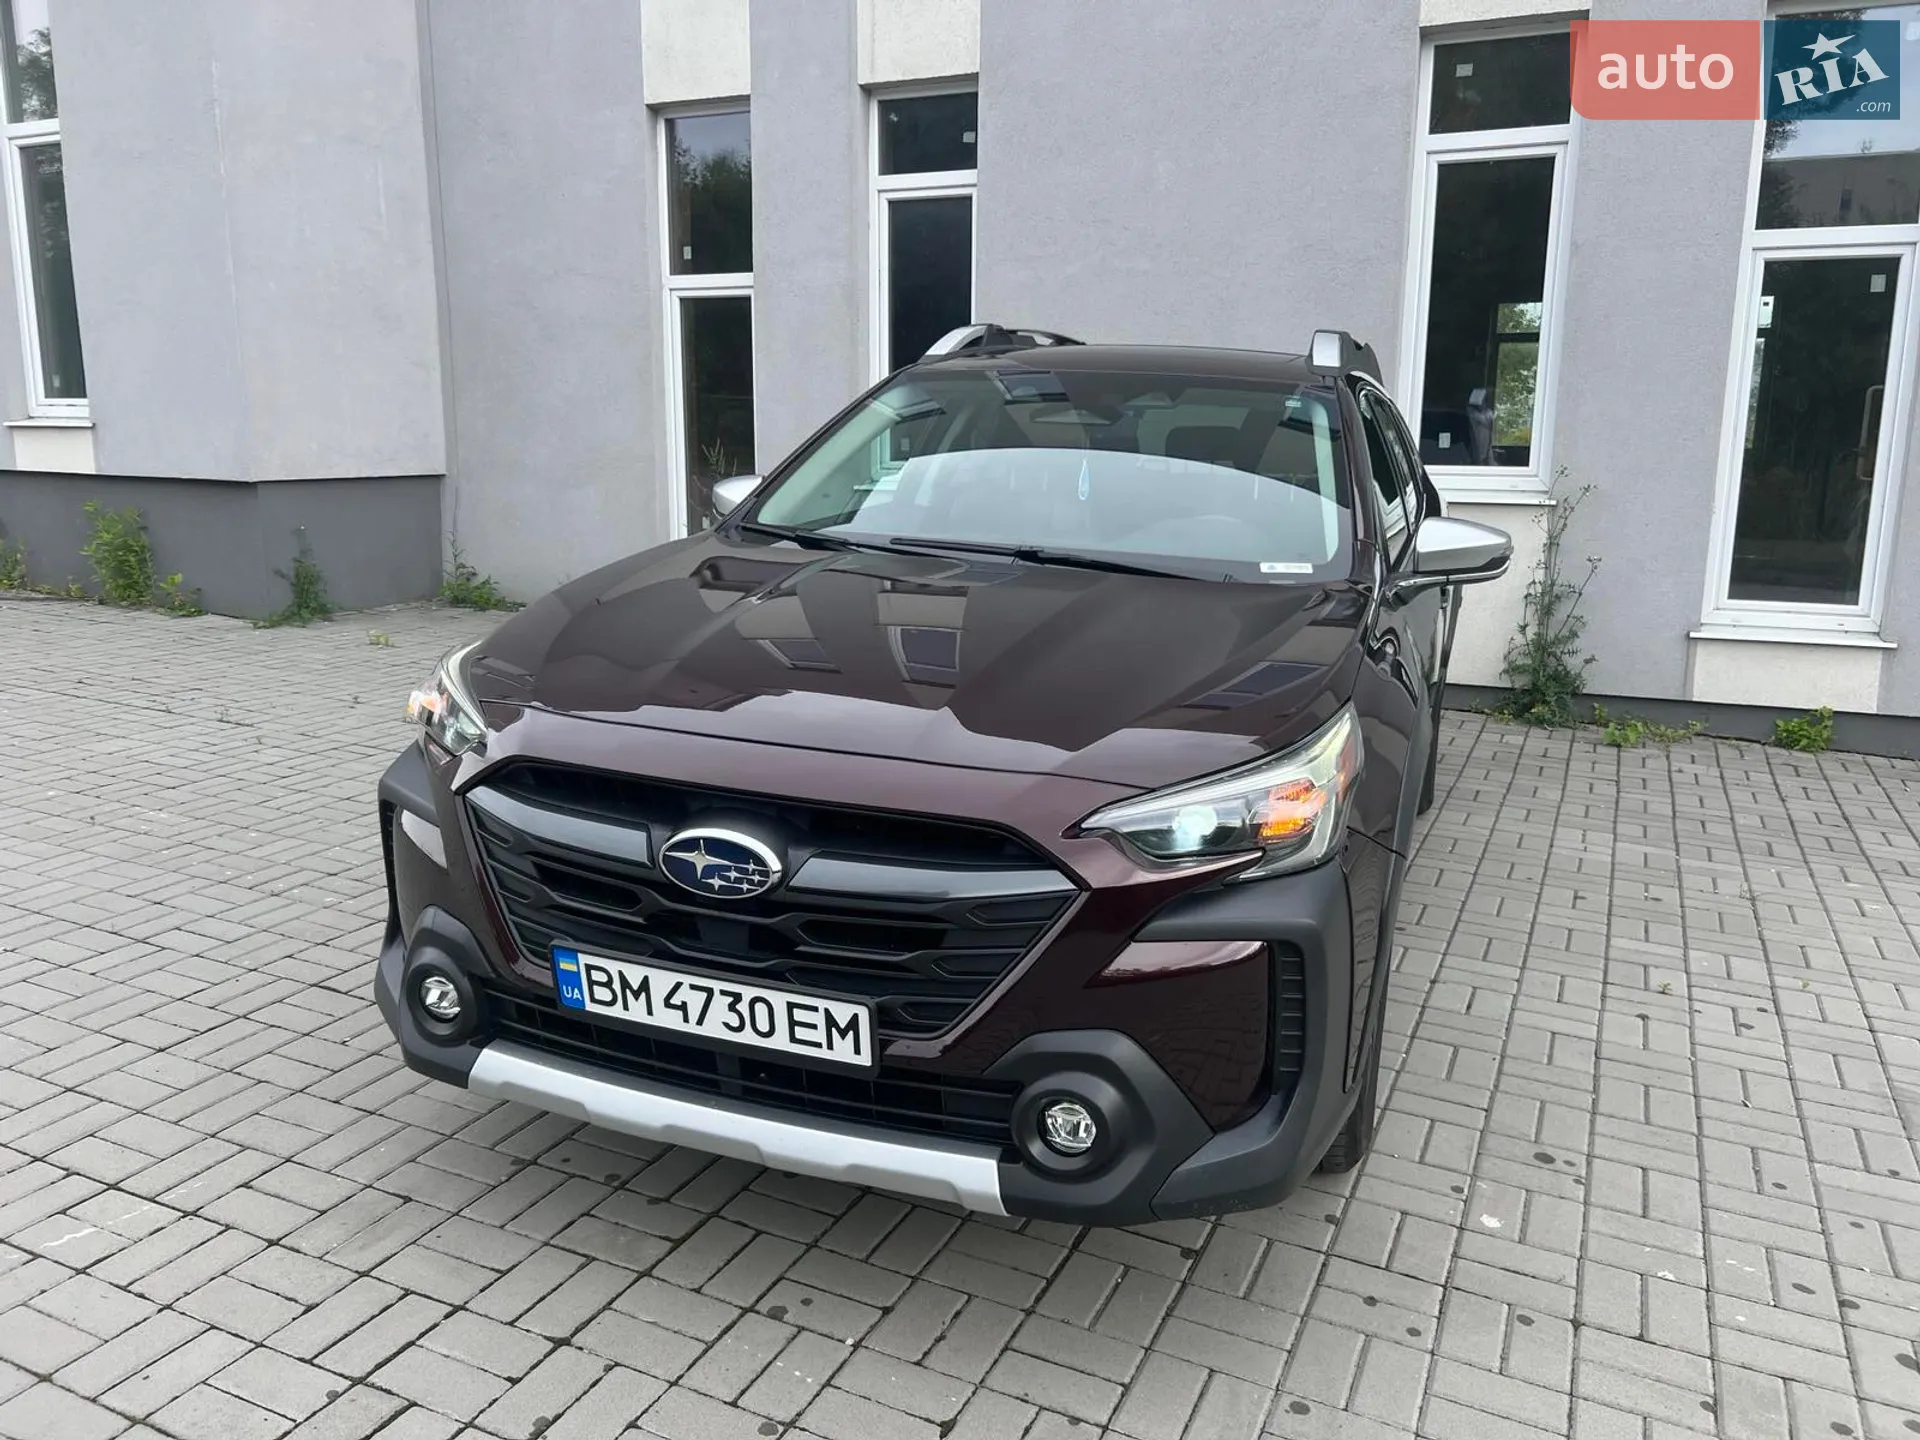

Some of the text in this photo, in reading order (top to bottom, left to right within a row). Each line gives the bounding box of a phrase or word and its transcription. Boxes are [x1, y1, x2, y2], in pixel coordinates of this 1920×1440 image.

[563, 985, 583, 1001] UA
[584, 963, 861, 1056] BM 4730 EM
